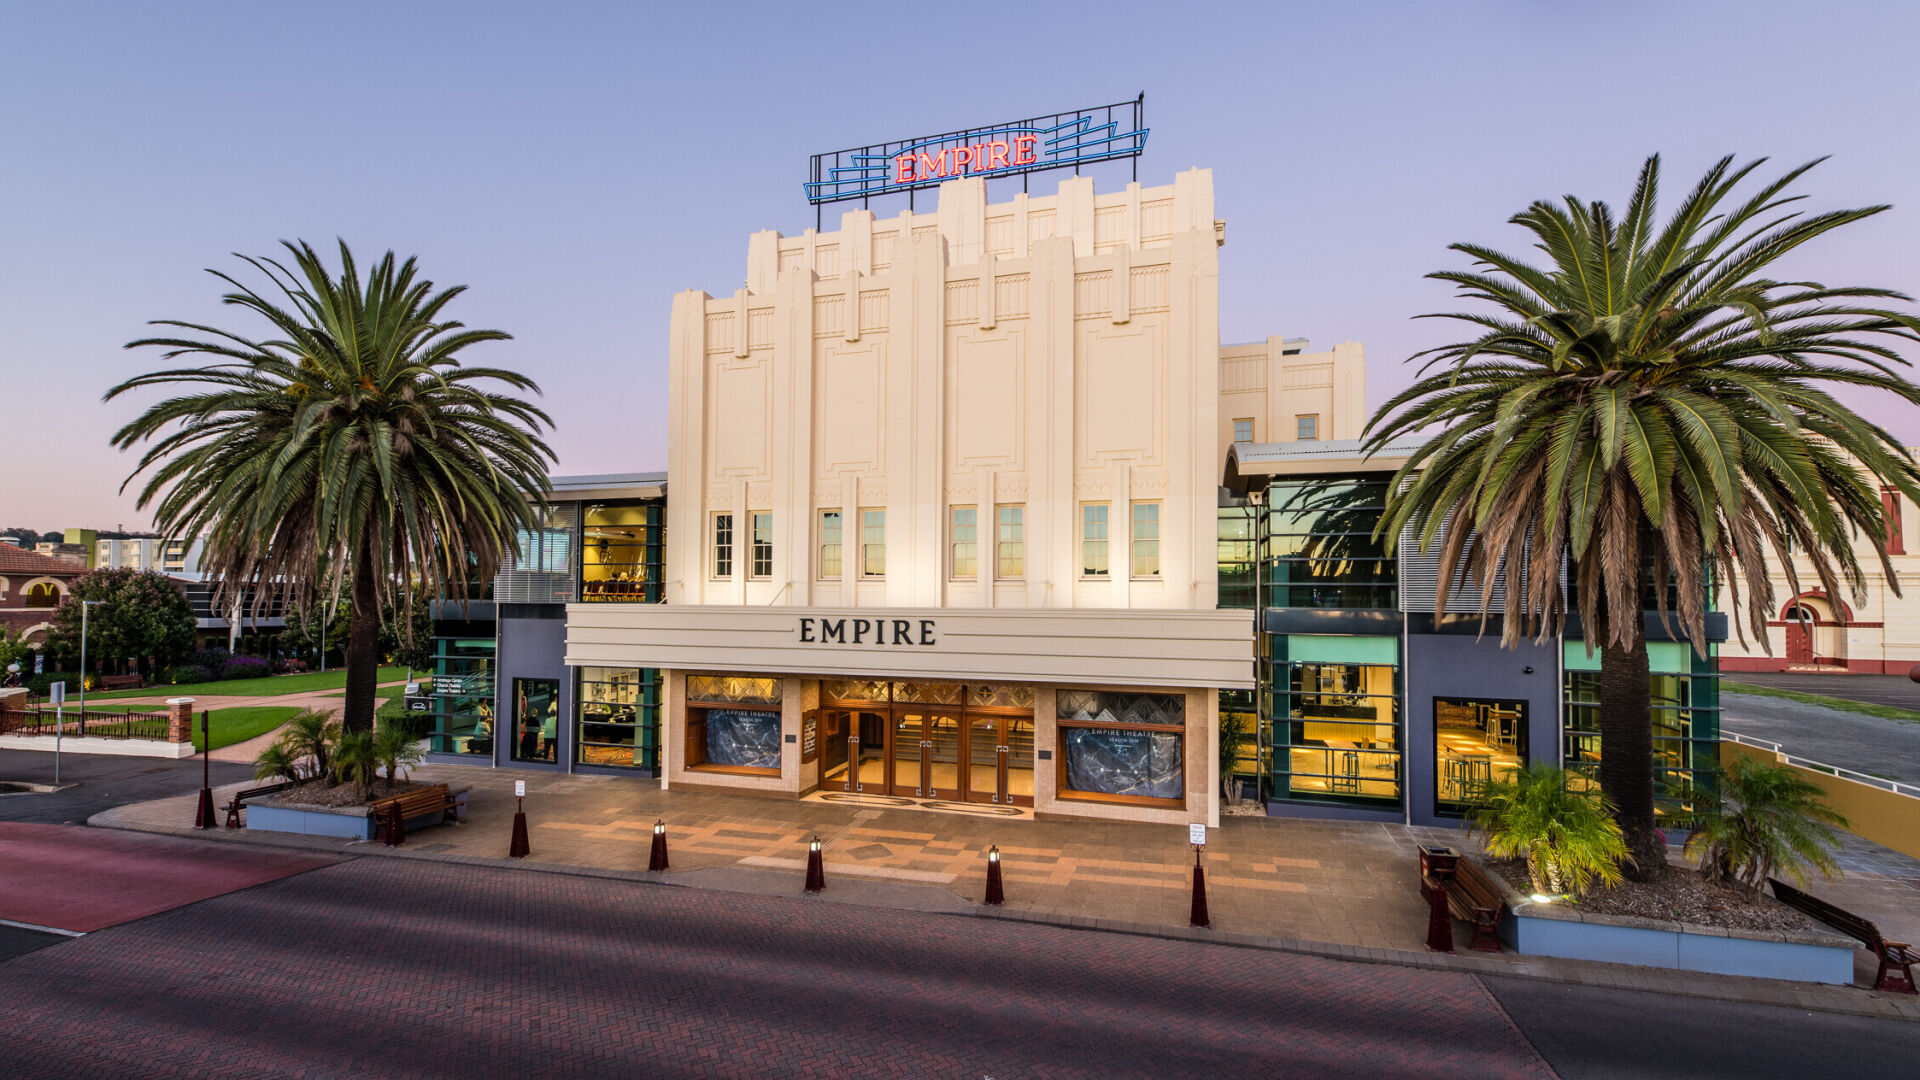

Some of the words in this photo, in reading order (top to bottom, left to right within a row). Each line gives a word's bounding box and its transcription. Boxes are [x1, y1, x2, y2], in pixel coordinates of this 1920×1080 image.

[895, 134, 1038, 184] EMPIRE
[799, 618, 936, 645] EMPIRE
[726, 709, 748, 717] EMPIRE
[1091, 728, 1120, 736] EMPIRE
